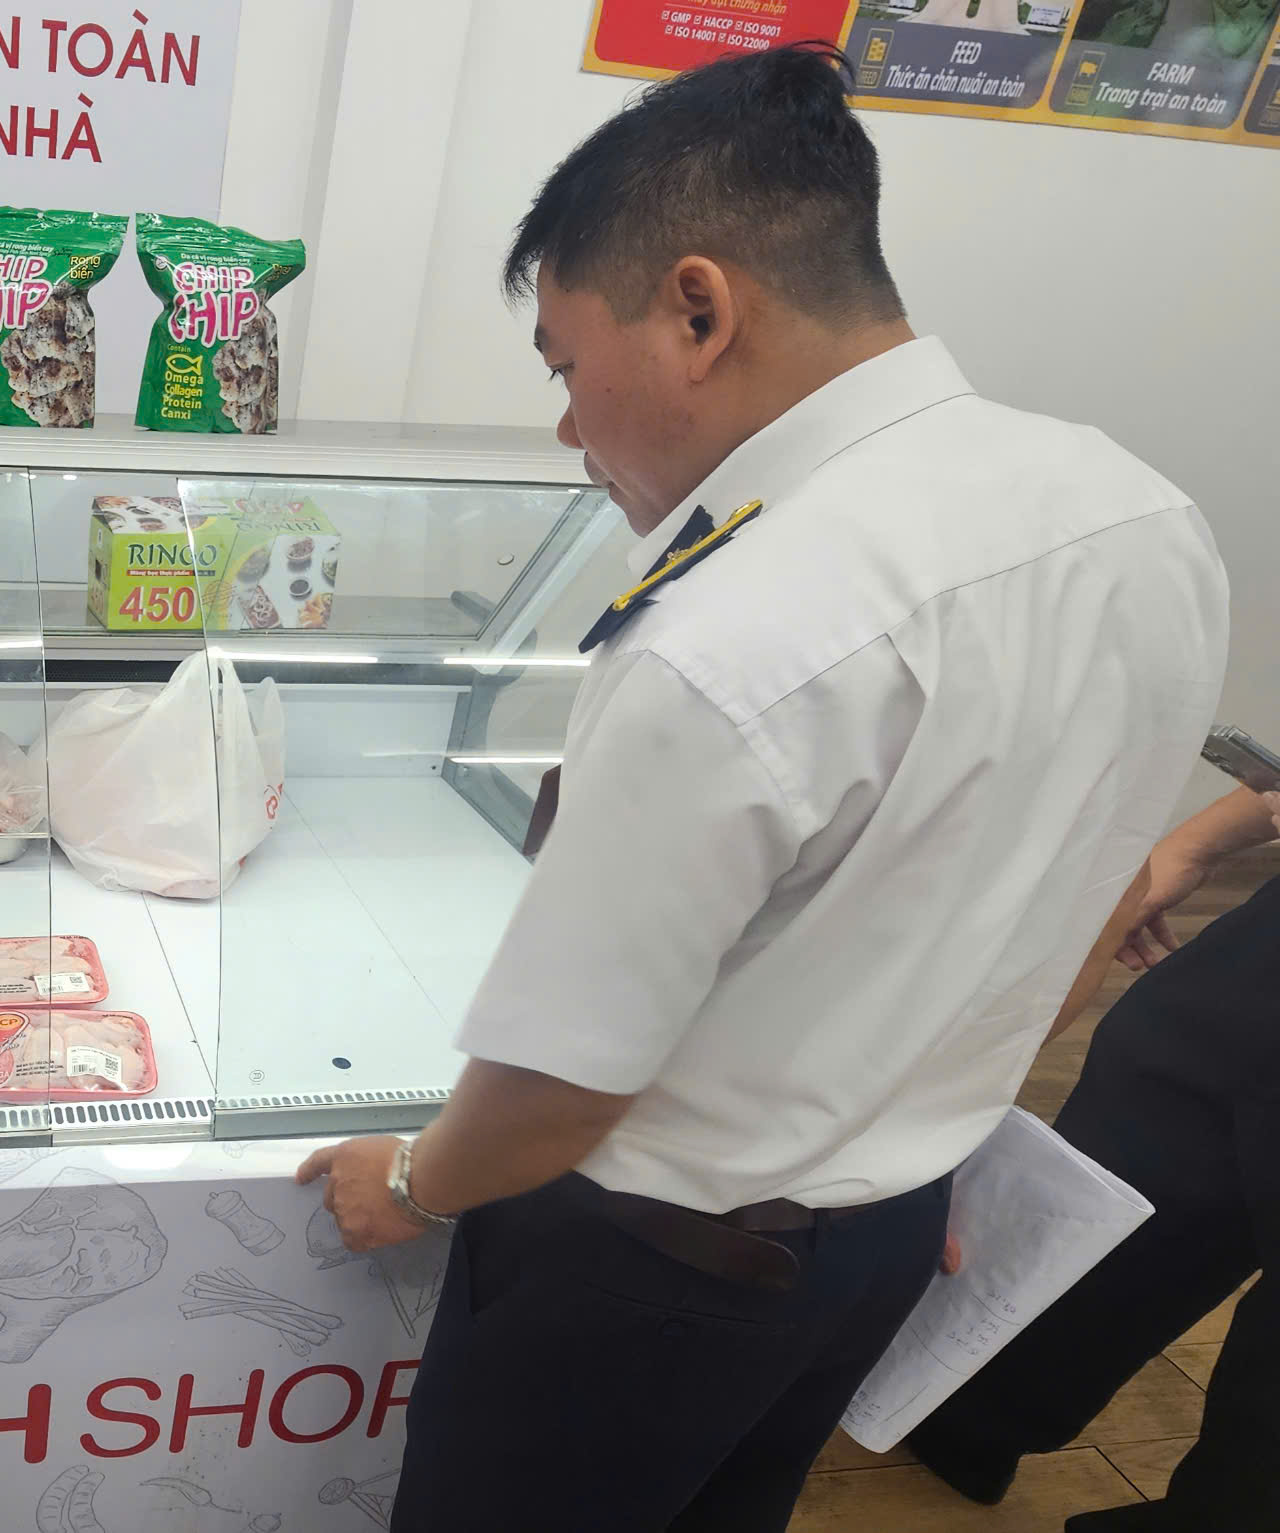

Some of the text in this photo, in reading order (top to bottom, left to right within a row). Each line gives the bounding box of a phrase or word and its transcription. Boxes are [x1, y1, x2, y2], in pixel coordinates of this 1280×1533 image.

[670, 11, 781, 37] GMP HACCP ISO 9001
[42, 9, 200, 87] TOÀN
[674, 26, 770, 51] ISO 14001 ISO 22000
[950, 40, 983, 65] FEED
[885, 65, 1025, 97] Thức ăn chăn nuôi an toàn
[1147, 62, 1196, 85] FARM
[1096, 82, 1140, 109] Trang
[1140, 89, 1171, 111] trại
[1170, 96, 1189, 110] an
[1191, 93, 1227, 114] toàn
[12, 244, 27, 252] rong
[70, 255, 101, 268] Rong
[173, 261, 254, 292] CHIP
[164, 383, 203, 399] Collagen
[165, 370, 204, 387] Omega
[161, 407, 192, 419] Canxi
[162, 394, 202, 409] Protein
[127, 543, 218, 568] RINGO
[119, 585, 196, 623] 450
[0, 1018, 18, 1026] CP
